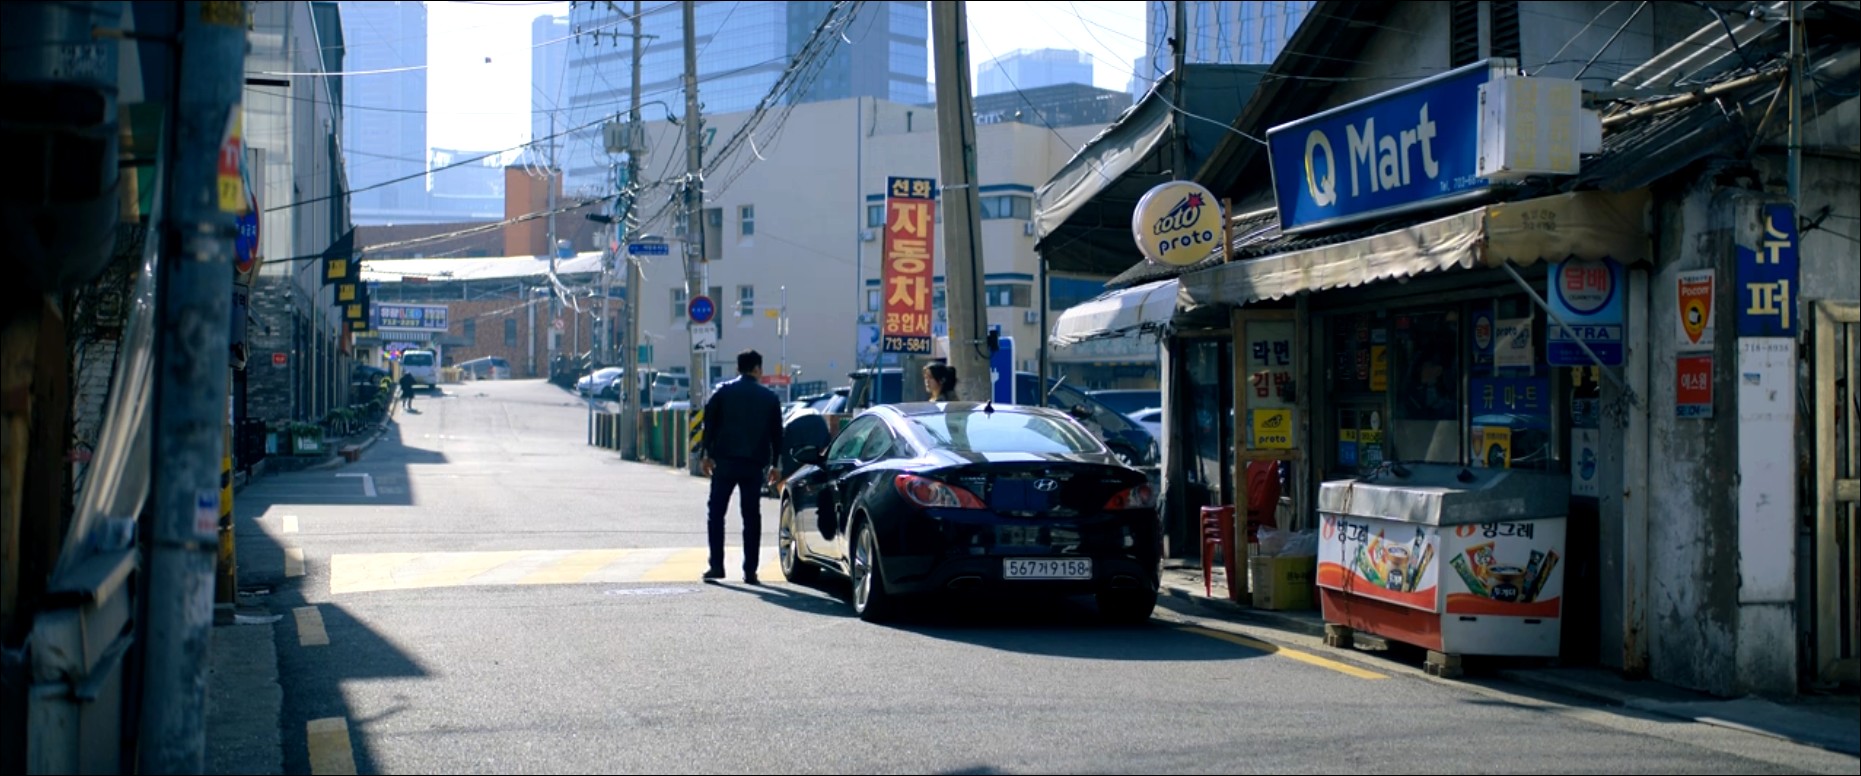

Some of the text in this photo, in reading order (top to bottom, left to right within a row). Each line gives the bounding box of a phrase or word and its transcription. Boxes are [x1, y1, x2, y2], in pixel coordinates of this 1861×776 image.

[1305, 129, 1337, 206] Q
[1346, 102, 1439, 197] Mart
[892, 179, 931, 199] 선화
[1159, 230, 1213, 256] proto
[888, 203, 931, 311] 자동차
[1565, 267, 1607, 292] 담배
[886, 313, 929, 333] 공업사
[885, 337, 930, 352] 713-5841
[1253, 340, 1290, 366] 라면
[1681, 372, 1707, 390] 에스원
[1259, 435, 1287, 443] proto
[1337, 519, 1369, 546] 빙그레
